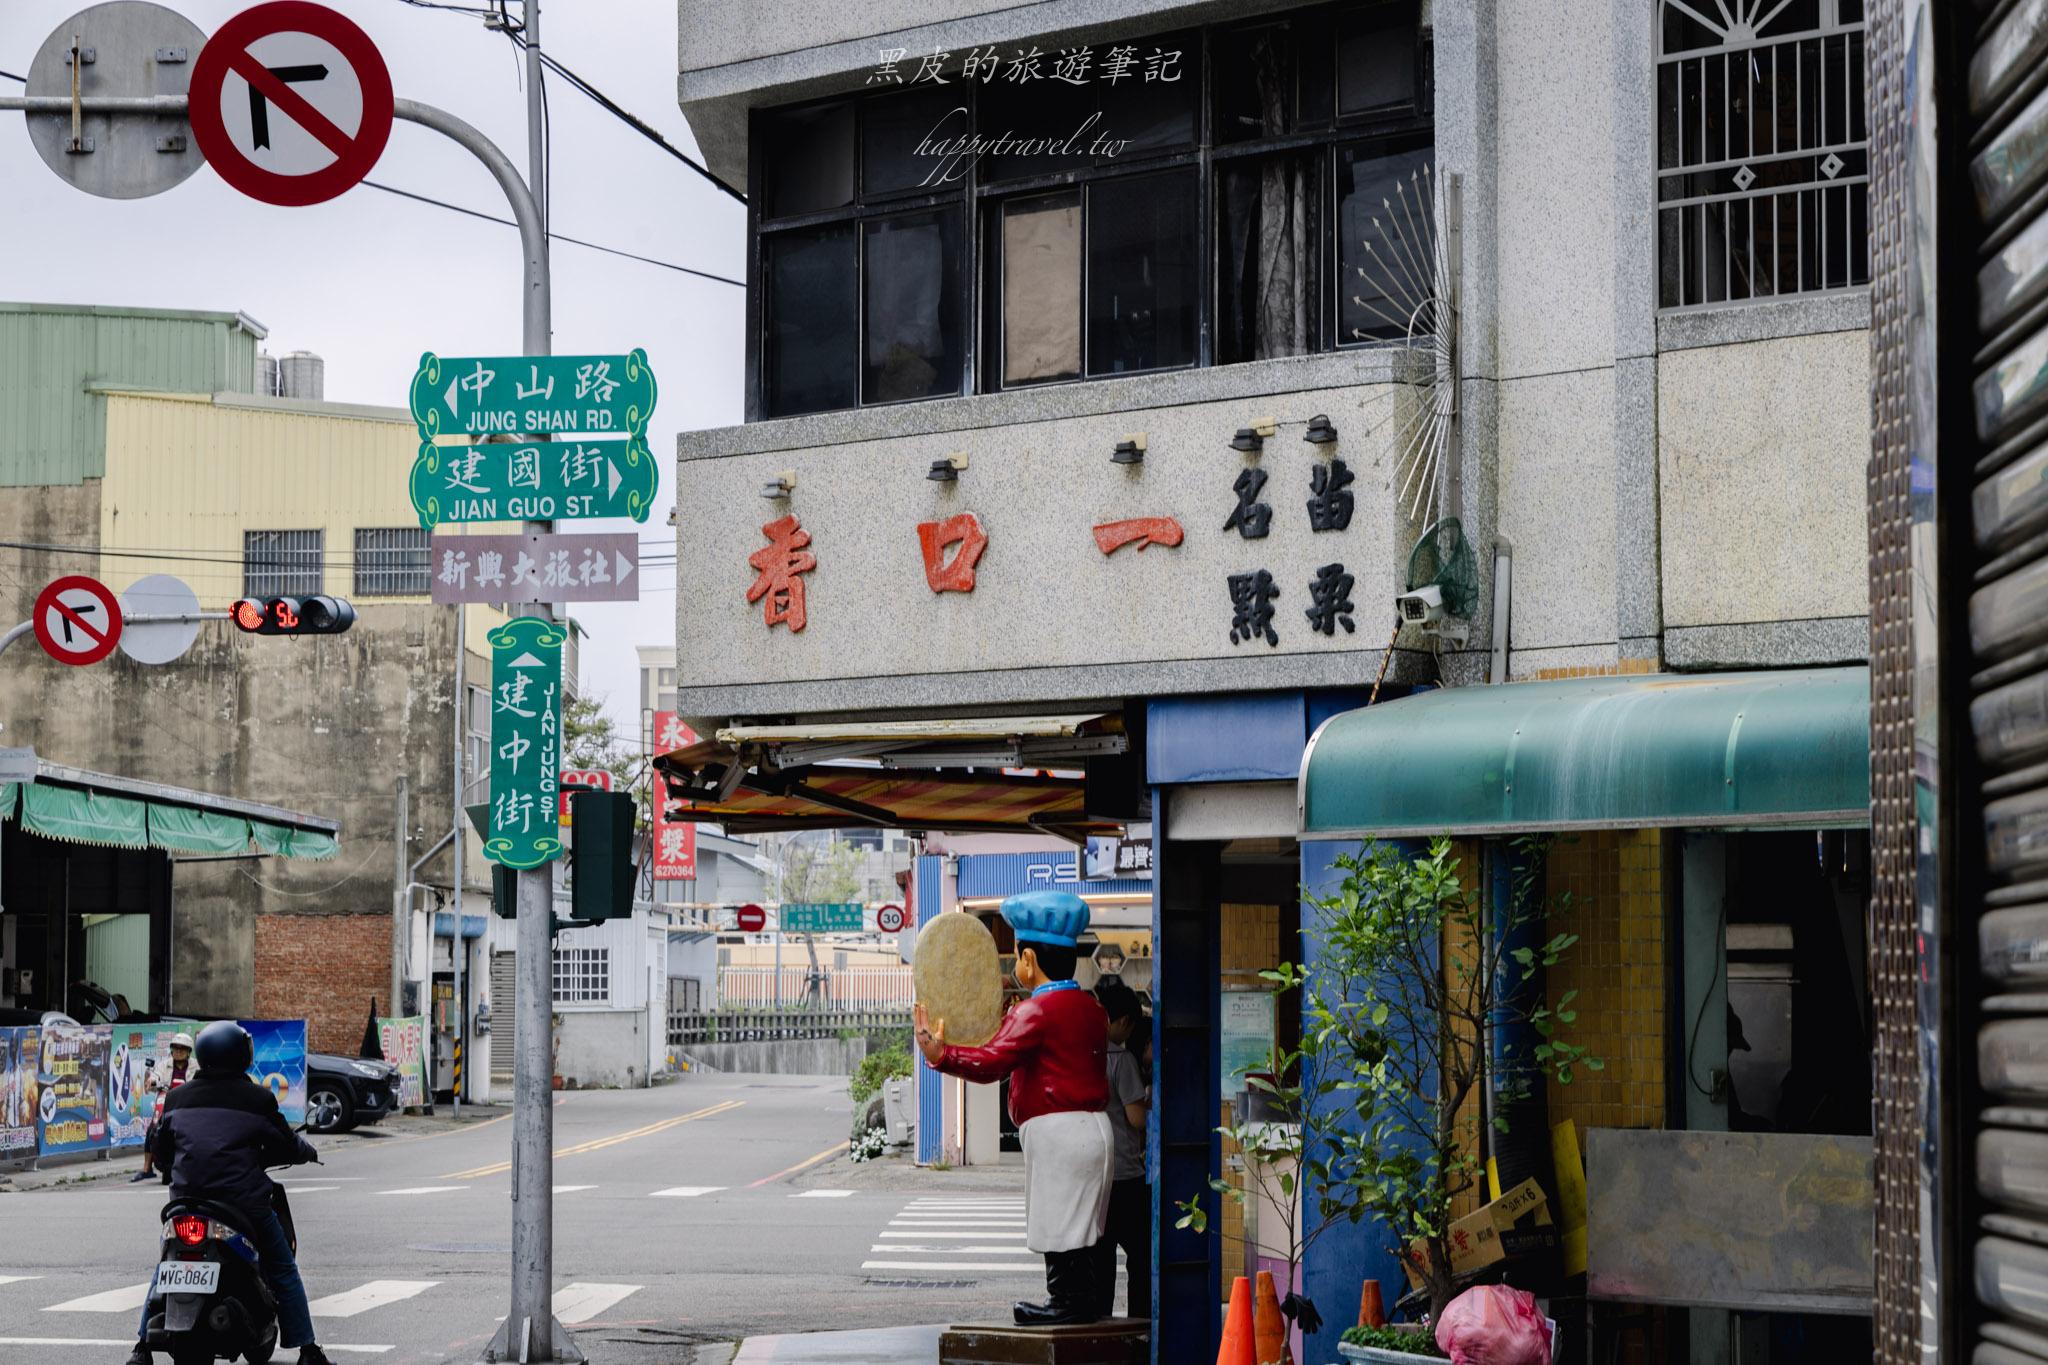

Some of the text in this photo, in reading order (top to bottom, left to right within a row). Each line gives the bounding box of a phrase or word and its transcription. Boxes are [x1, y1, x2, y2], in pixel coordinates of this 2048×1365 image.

[461, 360, 620, 405] 中山路
[466, 409, 617, 432] JUNG SHAN RD.
[444, 444, 603, 493] 建國街
[449, 495, 599, 520] JIAN GUO ST.
[437, 548, 611, 590] 新興大旅社
[493, 670, 536, 834] 建中街
[540, 682, 557, 824] JIAN JUNG ST.
[883, 913, 900, 924] 30
[160, 1269, 215, 1286] MVG-0861
